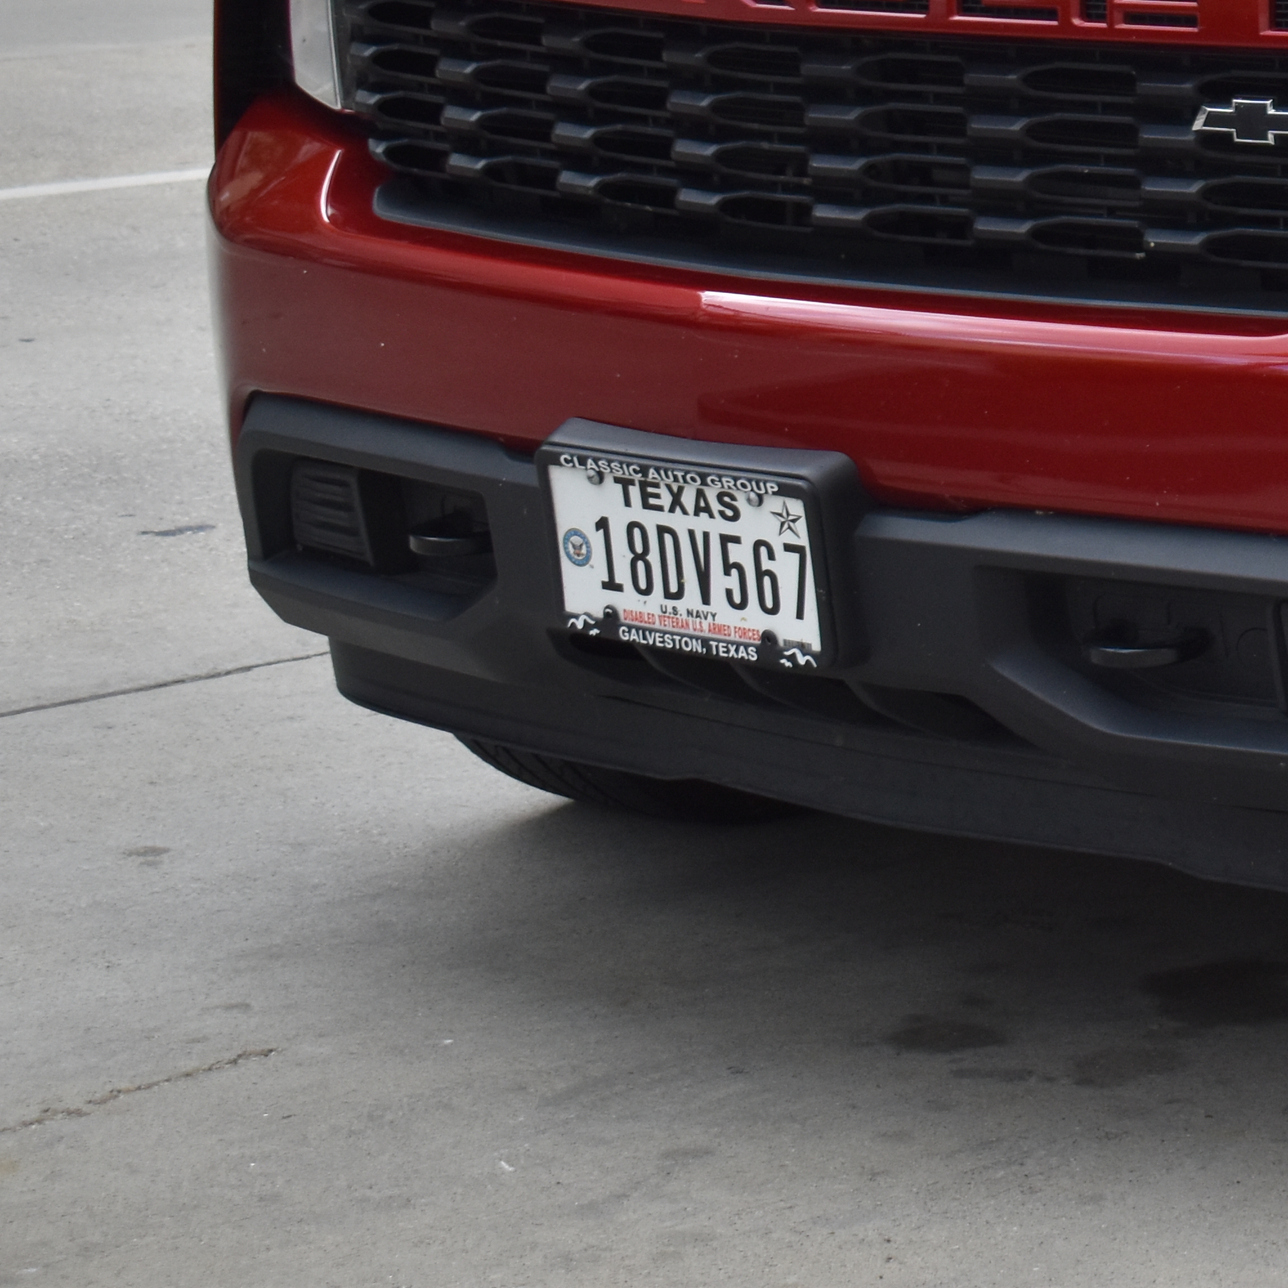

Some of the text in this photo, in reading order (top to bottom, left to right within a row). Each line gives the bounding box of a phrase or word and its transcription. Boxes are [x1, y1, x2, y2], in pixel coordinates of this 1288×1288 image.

[560, 454, 779, 496] CLASSIC AUTO GROUP
[613, 475, 742, 523] TEXAS
[594, 515, 808, 621] 18DV567
[623, 608, 761, 642] DISABLED VETERAN U.S. ARMED FORCES
[660, 604, 717, 622] U.S. NAVY
[618, 626, 759, 661] GALVESTON, TEXAS
